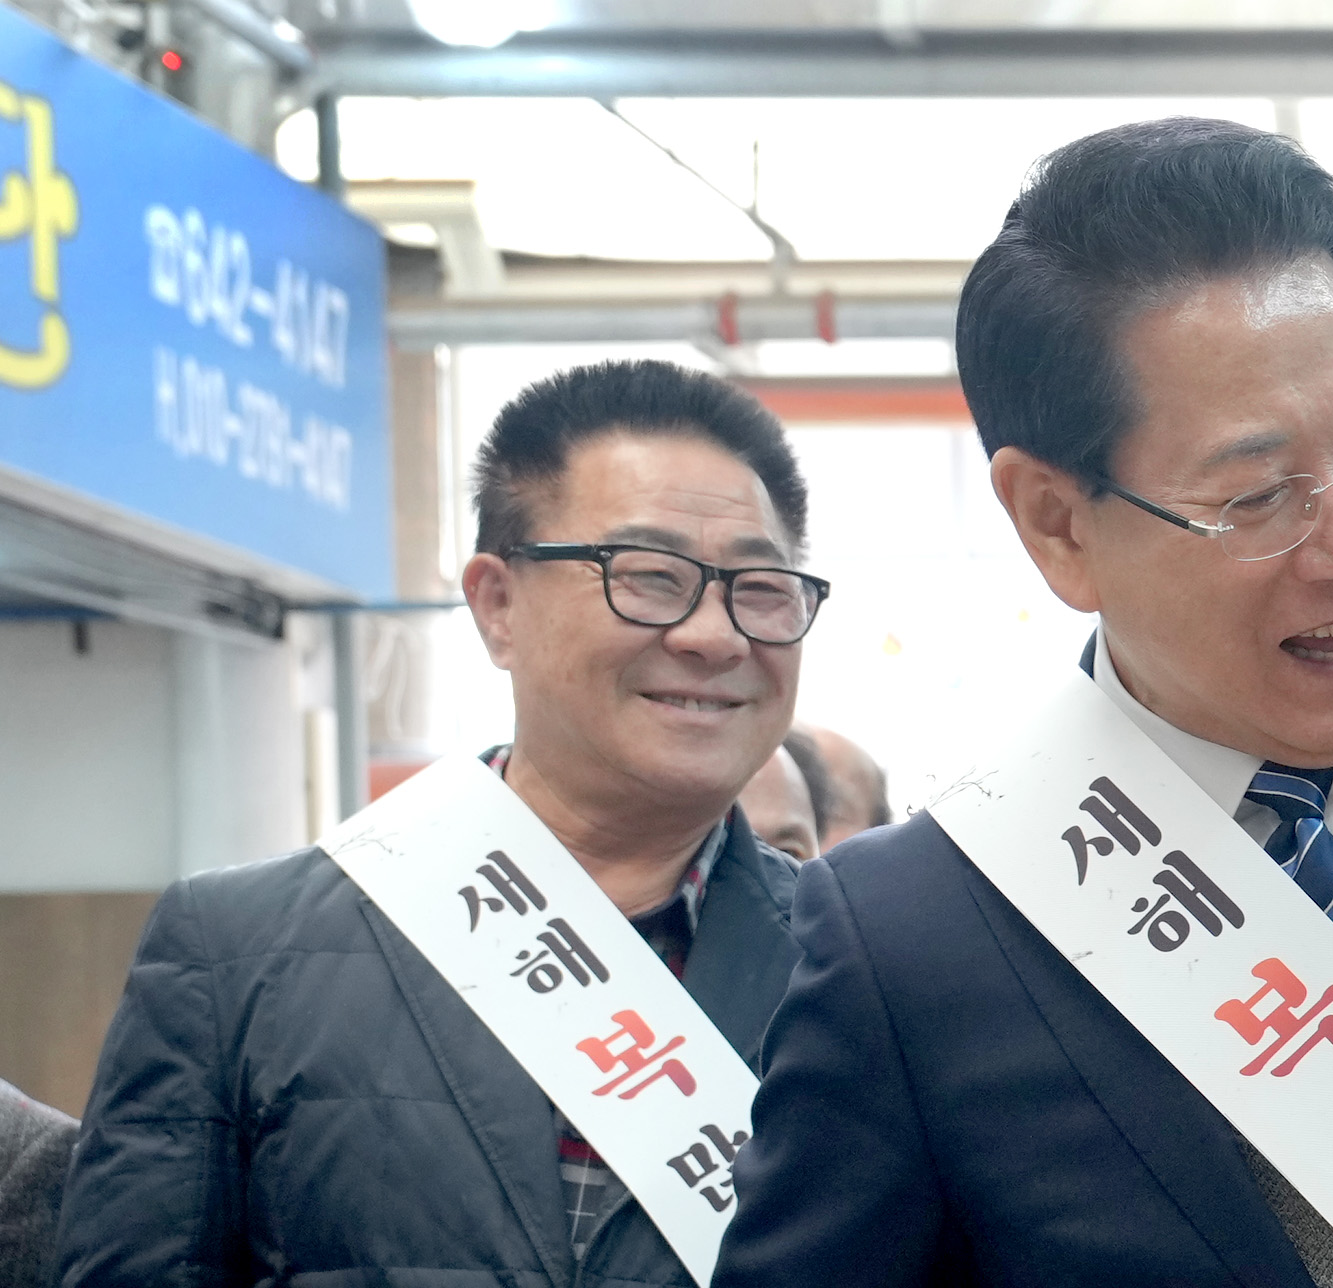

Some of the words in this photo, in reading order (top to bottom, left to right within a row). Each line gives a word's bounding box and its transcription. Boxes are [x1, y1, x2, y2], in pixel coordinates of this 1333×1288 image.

[1061, 776, 1245, 953] 새해
[458, 850, 611, 994] 새해
[576, 1009, 697, 1100] 복
